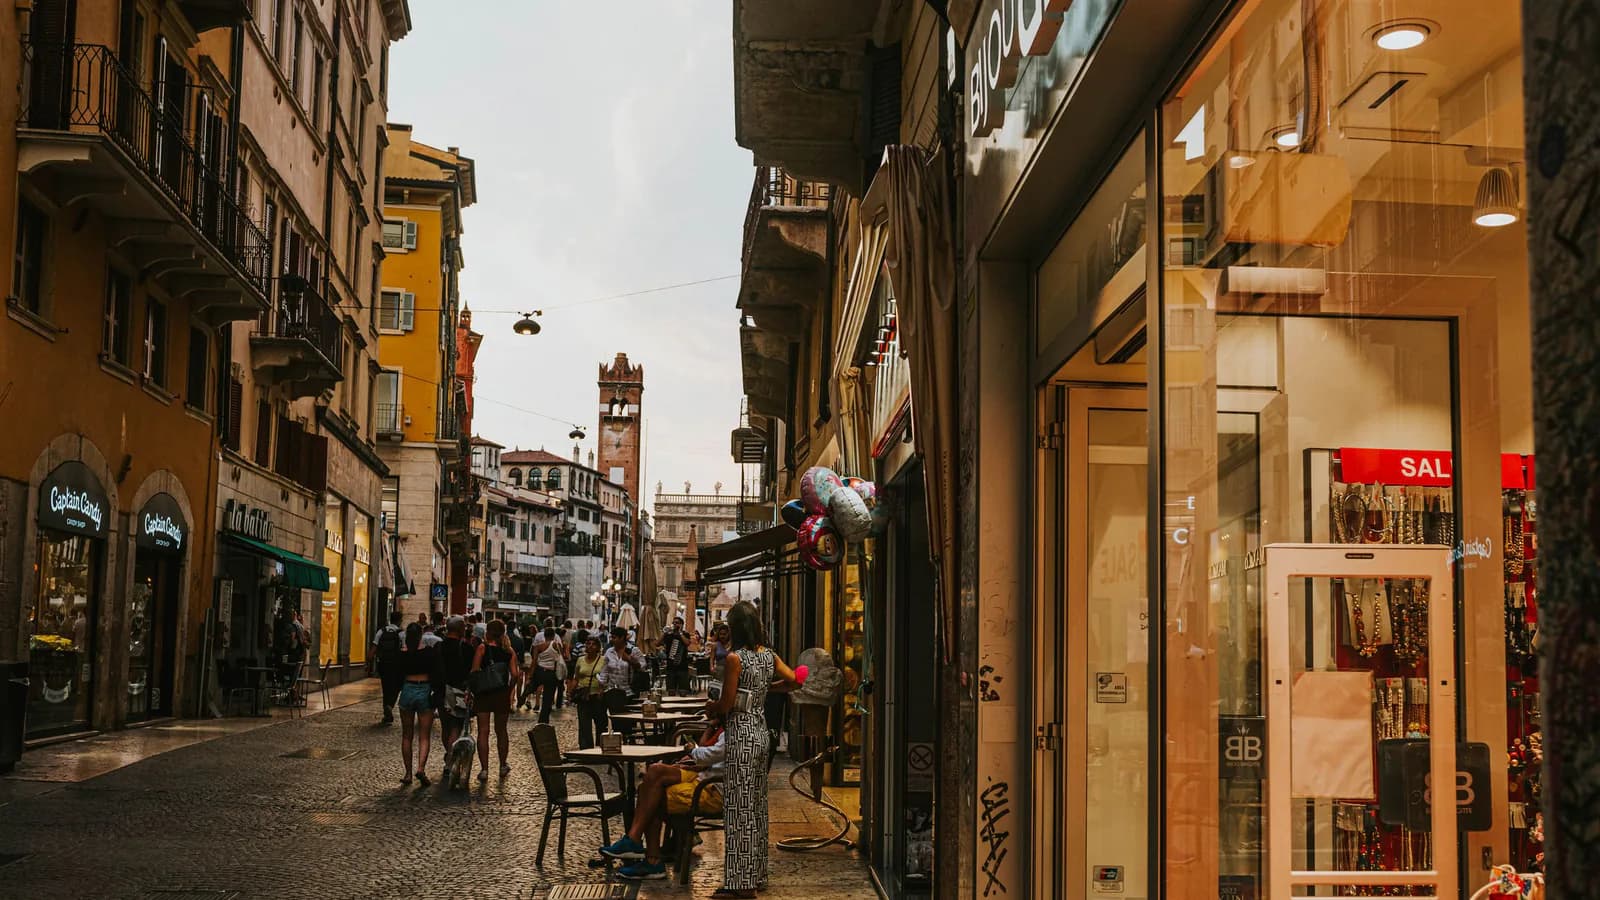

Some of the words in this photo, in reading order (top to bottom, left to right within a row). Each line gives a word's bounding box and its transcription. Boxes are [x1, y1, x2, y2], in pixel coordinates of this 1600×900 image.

[1400, 457, 1453, 478] SAL
[51, 486, 80, 516] Captain
[80, 492, 102, 532] Candy
[145, 513, 166, 537] Captain
[165, 516, 182, 550] Candy
